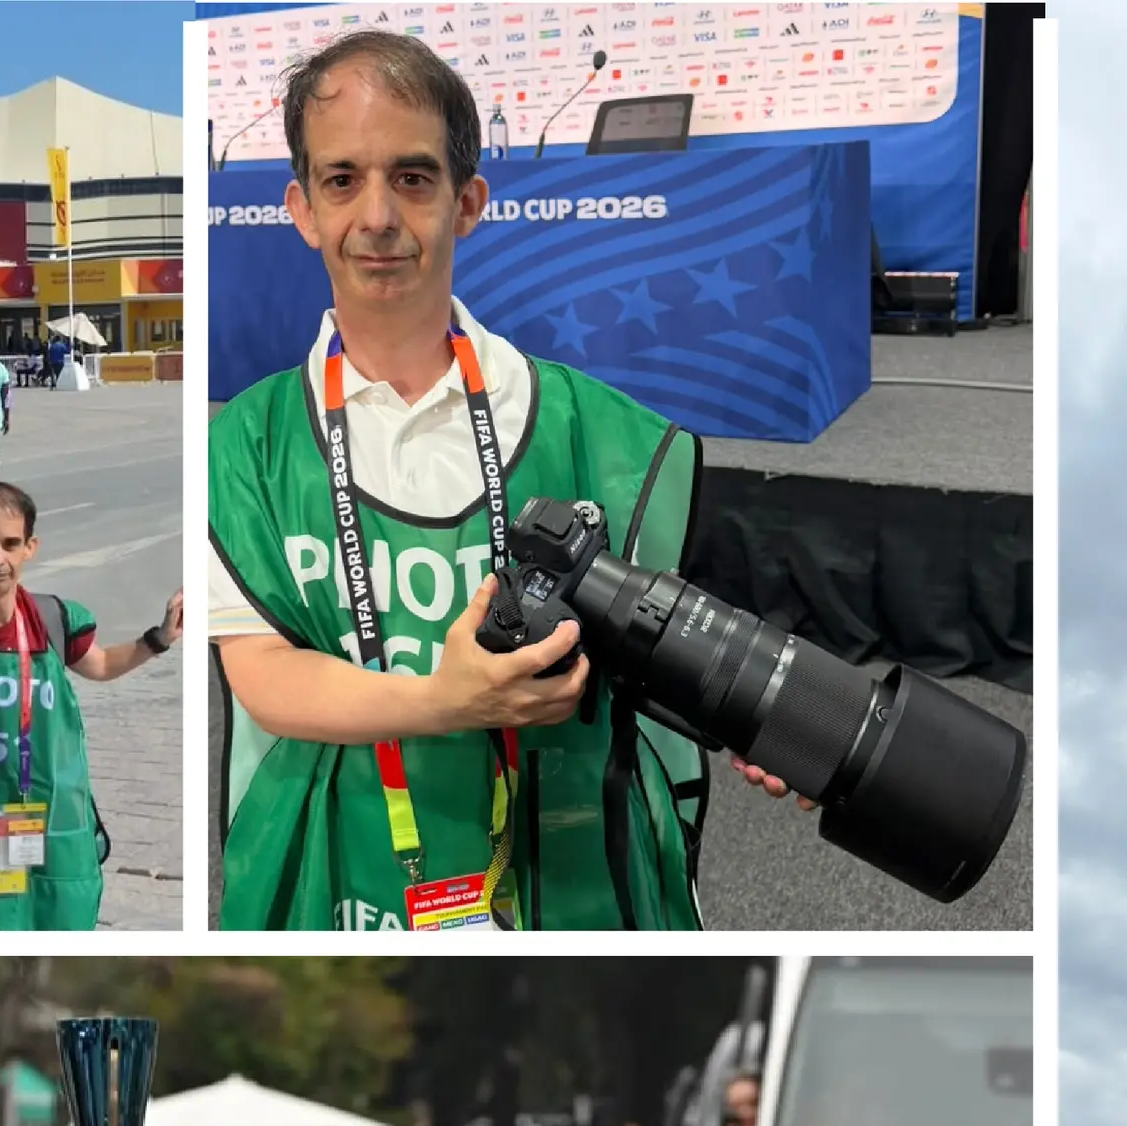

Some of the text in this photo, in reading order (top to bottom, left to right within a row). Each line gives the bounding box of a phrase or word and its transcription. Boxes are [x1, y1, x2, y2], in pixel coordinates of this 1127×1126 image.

[229, 205, 293, 225] 2026
[524, 199, 573, 221] CUP
[576, 194, 667, 219] 2026
[473, 409, 490, 447] FIFA
[481, 448, 504, 512] WORLD
[330, 425, 376, 640] FIFA WORLD CUP 2026
[492, 515, 505, 551] CUP
[284, 534, 493, 622] PHOT
[433, 894, 462, 905] WORLD
[462, 890, 480, 900] CUP
